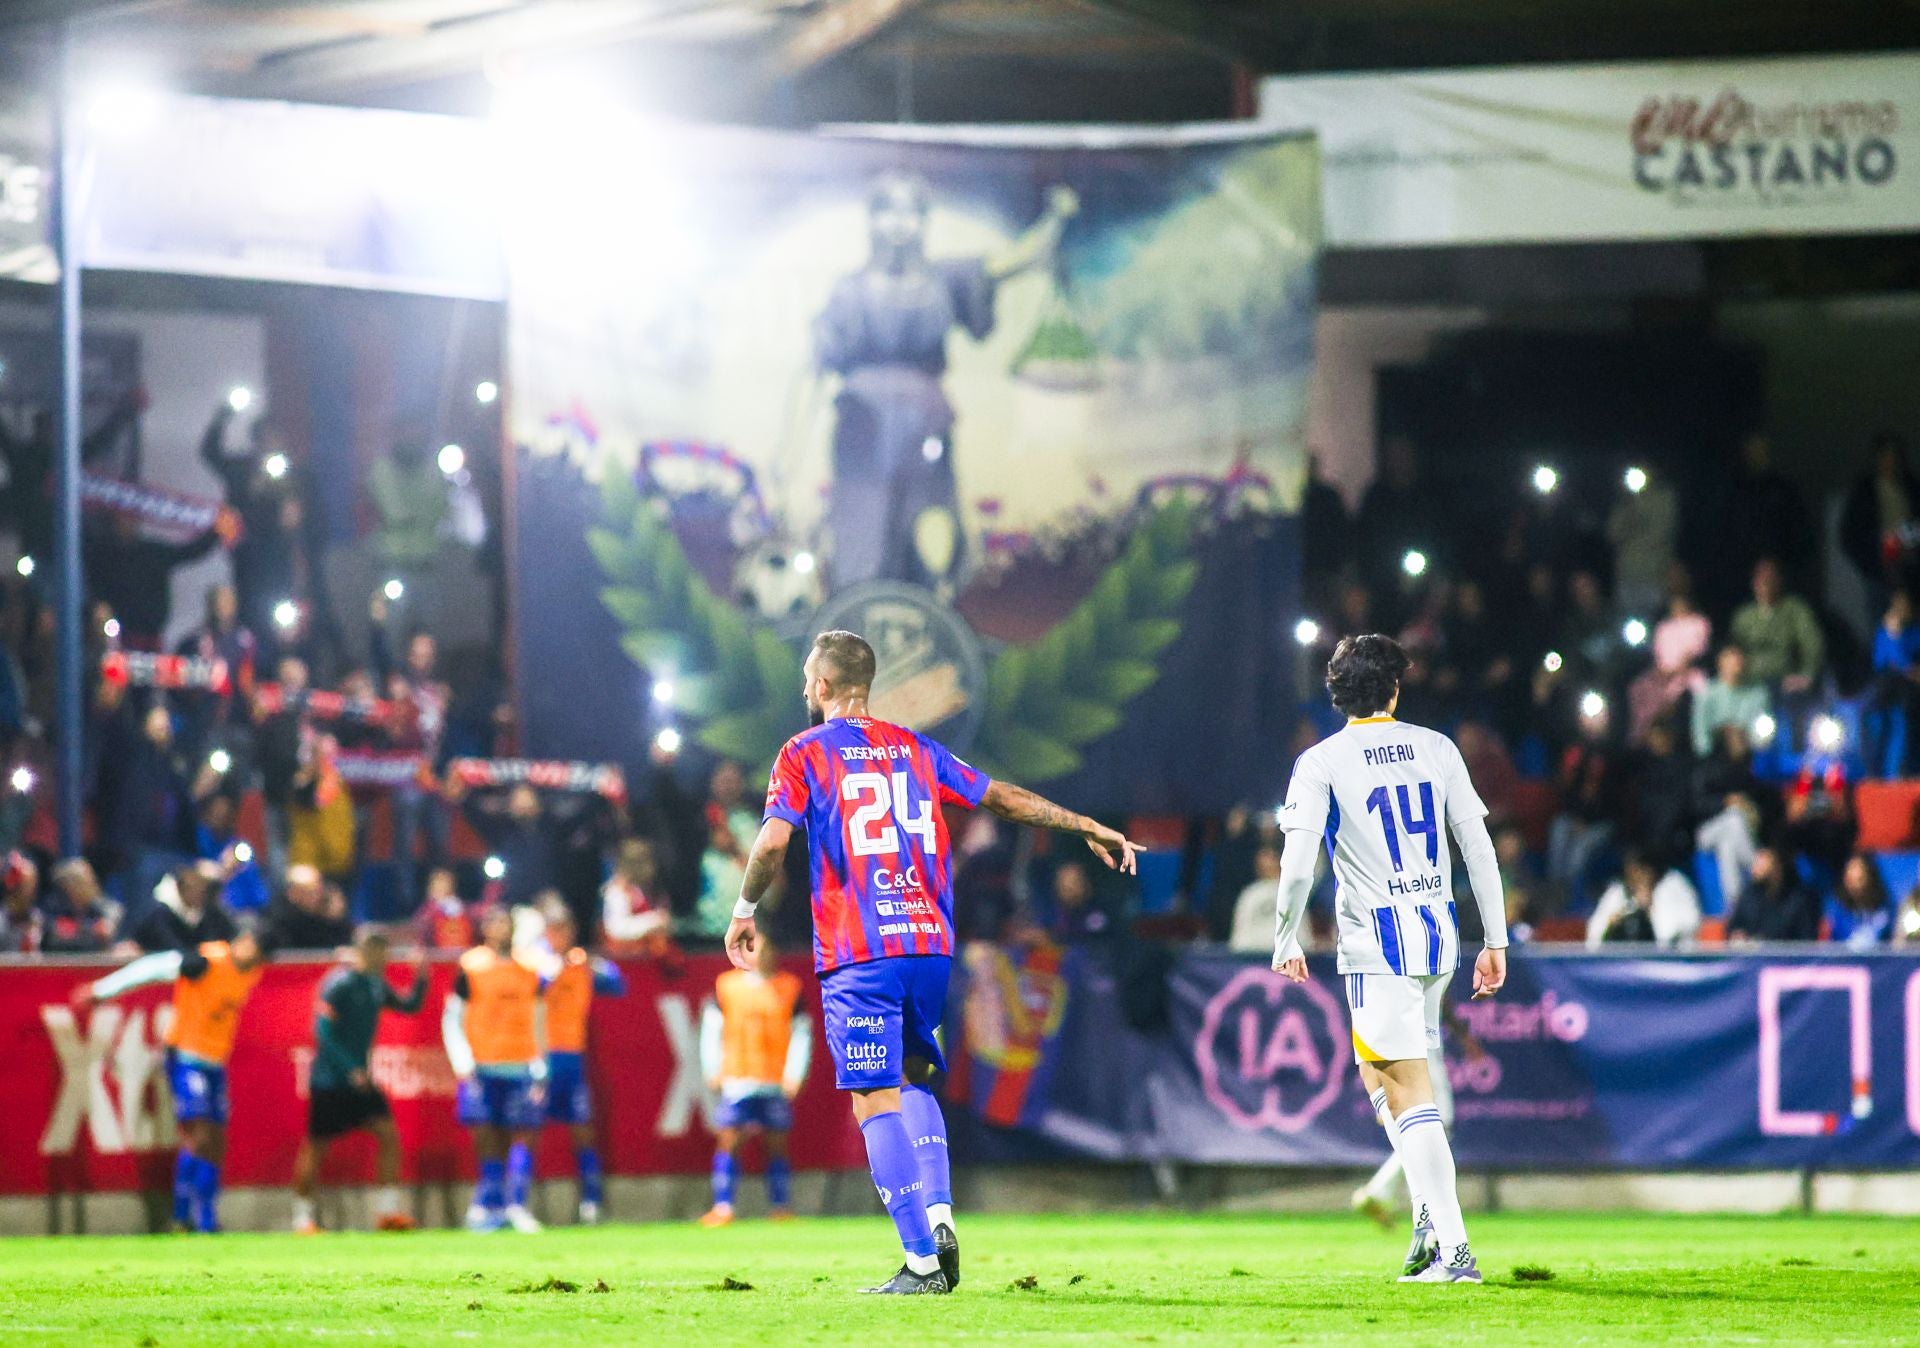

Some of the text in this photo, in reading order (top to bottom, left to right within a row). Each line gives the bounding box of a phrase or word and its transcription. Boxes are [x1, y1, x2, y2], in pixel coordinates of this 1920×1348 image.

[840, 745, 912, 760] JOSEMA G M
[1364, 744, 1415, 766] PINEAU
[841, 772, 937, 857] 24
[1366, 781, 1438, 873] 14
[1388, 874, 1442, 896] Huelva
[846, 1016, 884, 1028] KOALA
[846, 1042, 887, 1059] tutto
[846, 1058, 886, 1071] confort
